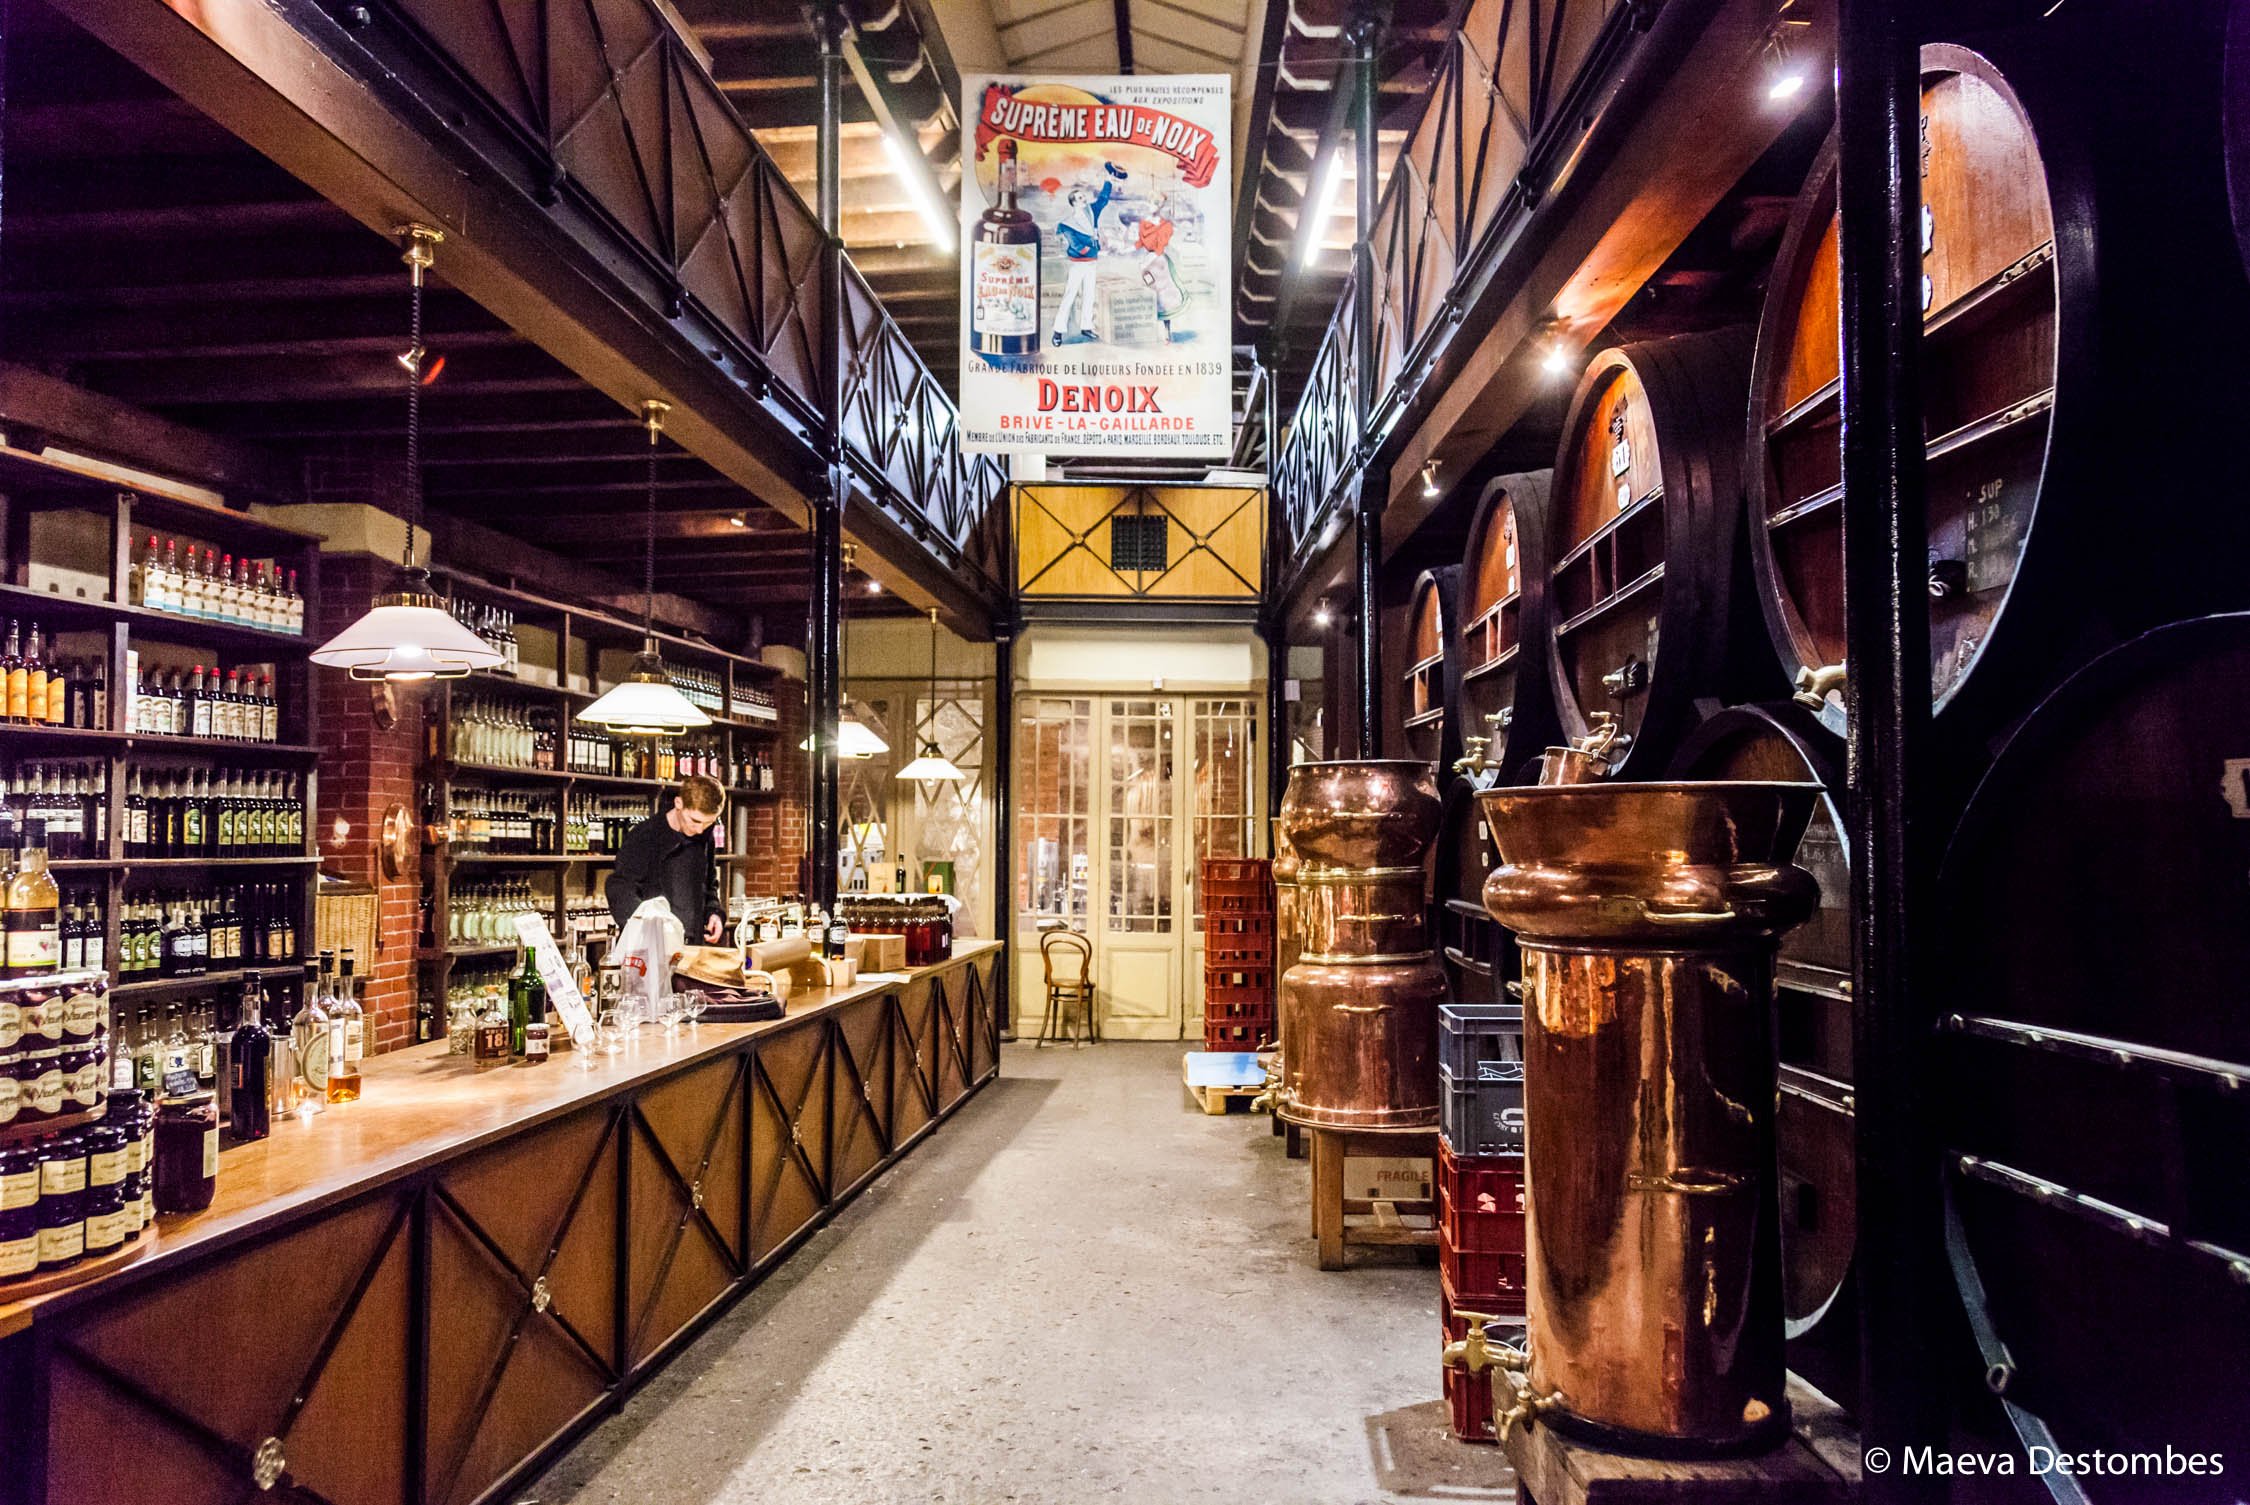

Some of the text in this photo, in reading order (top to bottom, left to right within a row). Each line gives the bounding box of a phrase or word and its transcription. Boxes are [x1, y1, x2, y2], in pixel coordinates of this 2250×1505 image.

[1126, 86, 1143, 94] PLUS
[1152, 97, 1205, 105] EXPOSITIONS
[990, 98, 1207, 161] SUPRÊME EAU DE NOIX
[1064, 363, 1078, 375] DE
[1081, 362, 1131, 377] LIQUEURS
[1178, 364, 1192, 376] EN
[1196, 362, 1223, 376] 1839
[1037, 378, 1163, 413] DENOIX
[1000, 415, 1195, 431] BRIVE-LA-GAILLARDE
[966, 429, 988, 442] MEMBRE
[1978, 478, 2003, 504] SUP
[1377, 1170, 1429, 1182] FRAGILE
